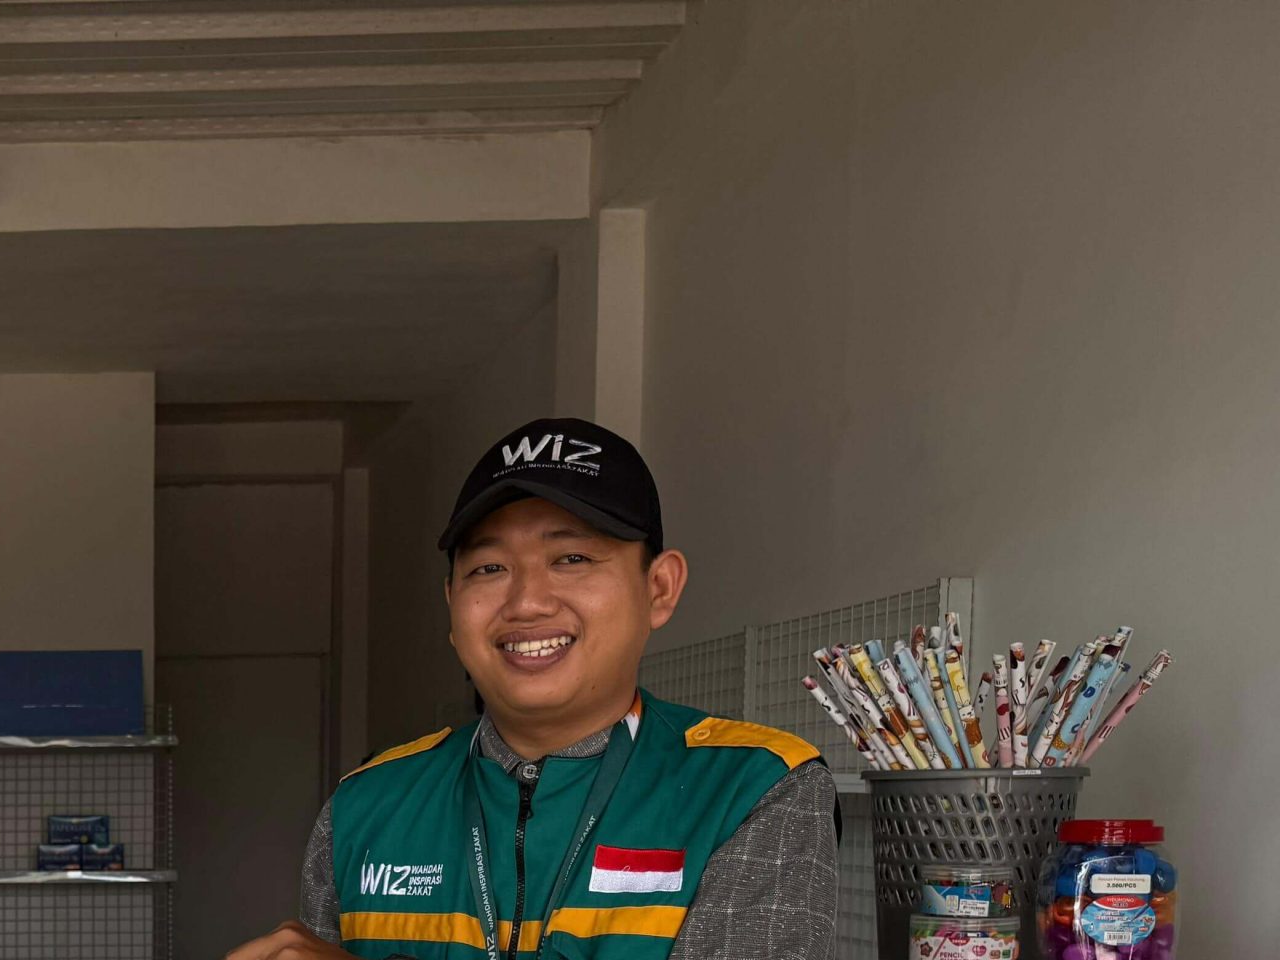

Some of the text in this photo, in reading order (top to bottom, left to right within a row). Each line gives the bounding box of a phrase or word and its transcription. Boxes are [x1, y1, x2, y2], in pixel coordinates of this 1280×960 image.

[579, 814, 596, 843] ZAKAT
[471, 826, 482, 852] ZAKAT
[411, 864, 443, 874] WAHDAH
[475, 853, 488, 892] INSPIRASI
[408, 875, 443, 886] INSPIRASI
[406, 886, 433, 896] ZAKAT
